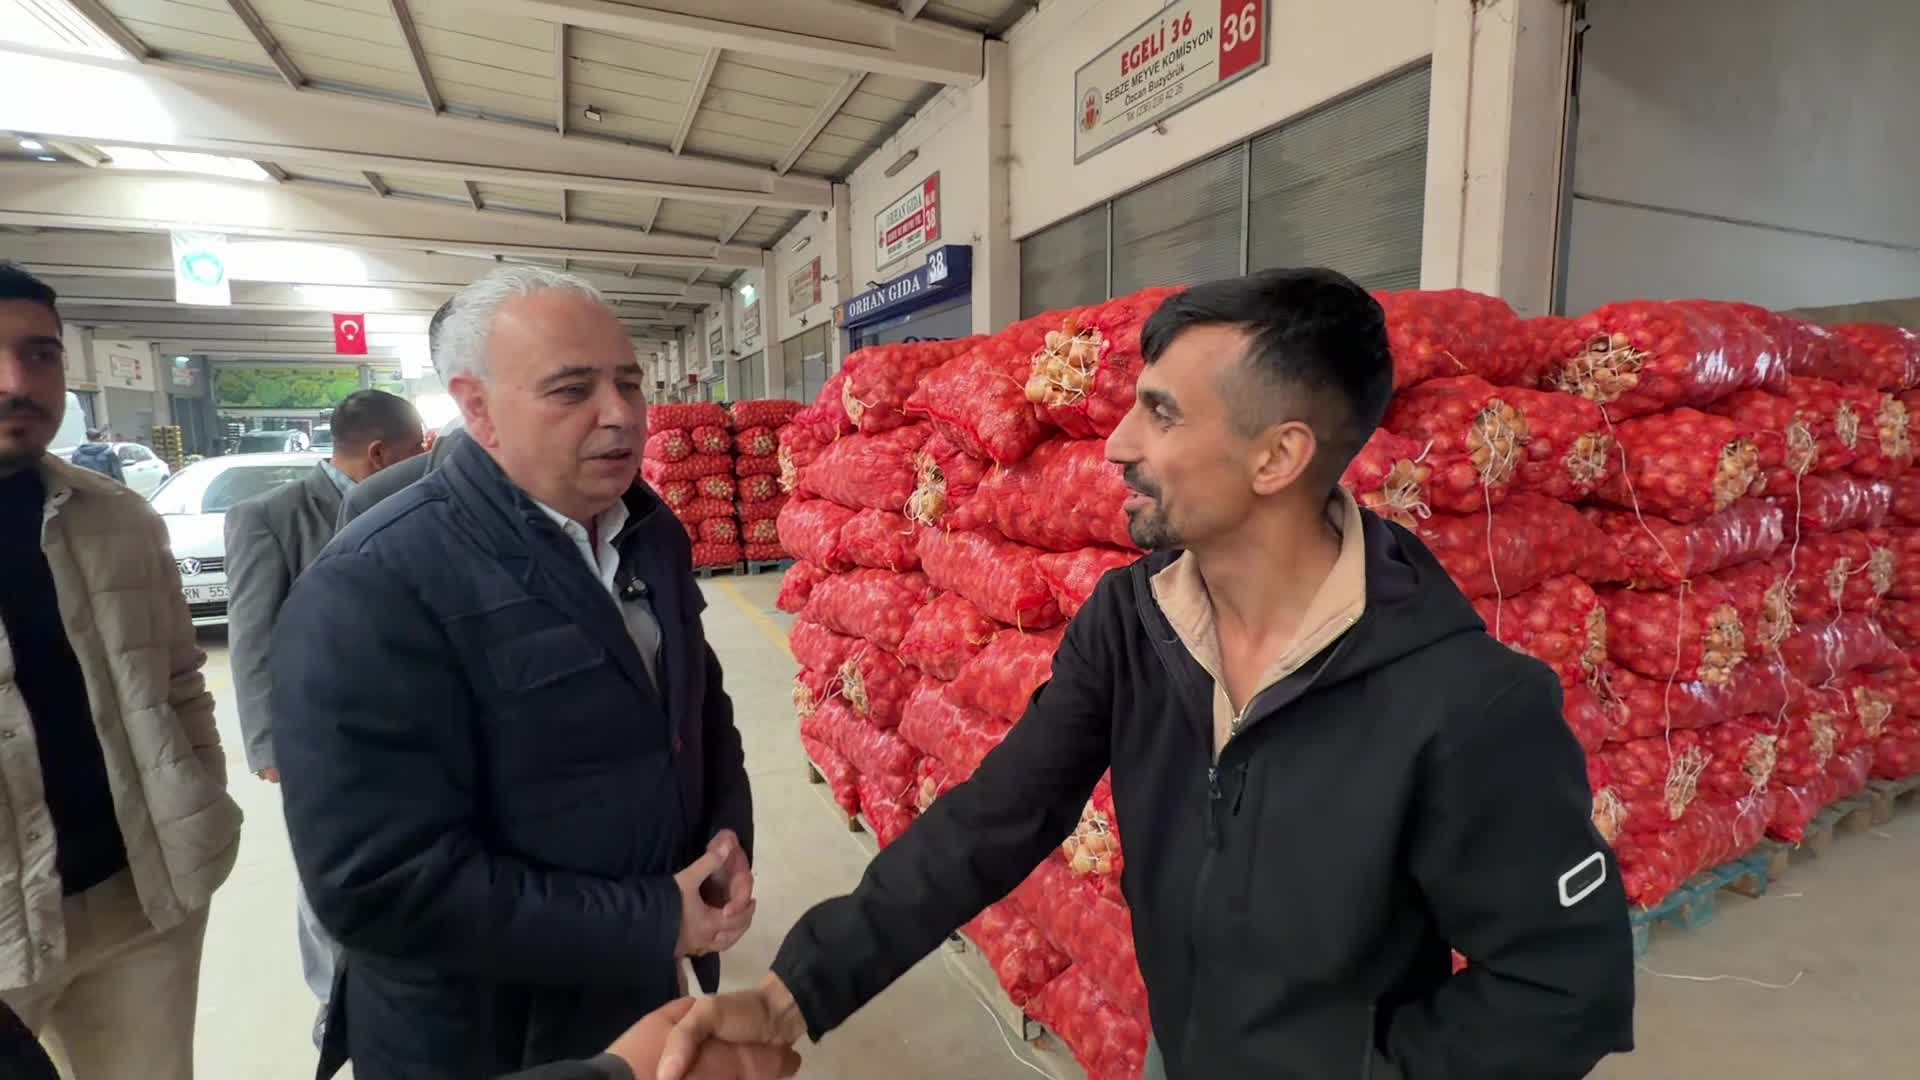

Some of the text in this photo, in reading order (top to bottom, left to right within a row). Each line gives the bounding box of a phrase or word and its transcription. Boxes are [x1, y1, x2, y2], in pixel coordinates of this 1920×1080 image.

[1121, 11, 1193, 77] EGELİ 36
[1223, 3, 1256, 52] 36
[1105, 27, 1213, 104] SEBZE MEYVE KOMİSYON
[926, 207, 936, 231] 38
[929, 250, 944, 282] 38
[849, 275, 920, 317] ORHAN GIDA
